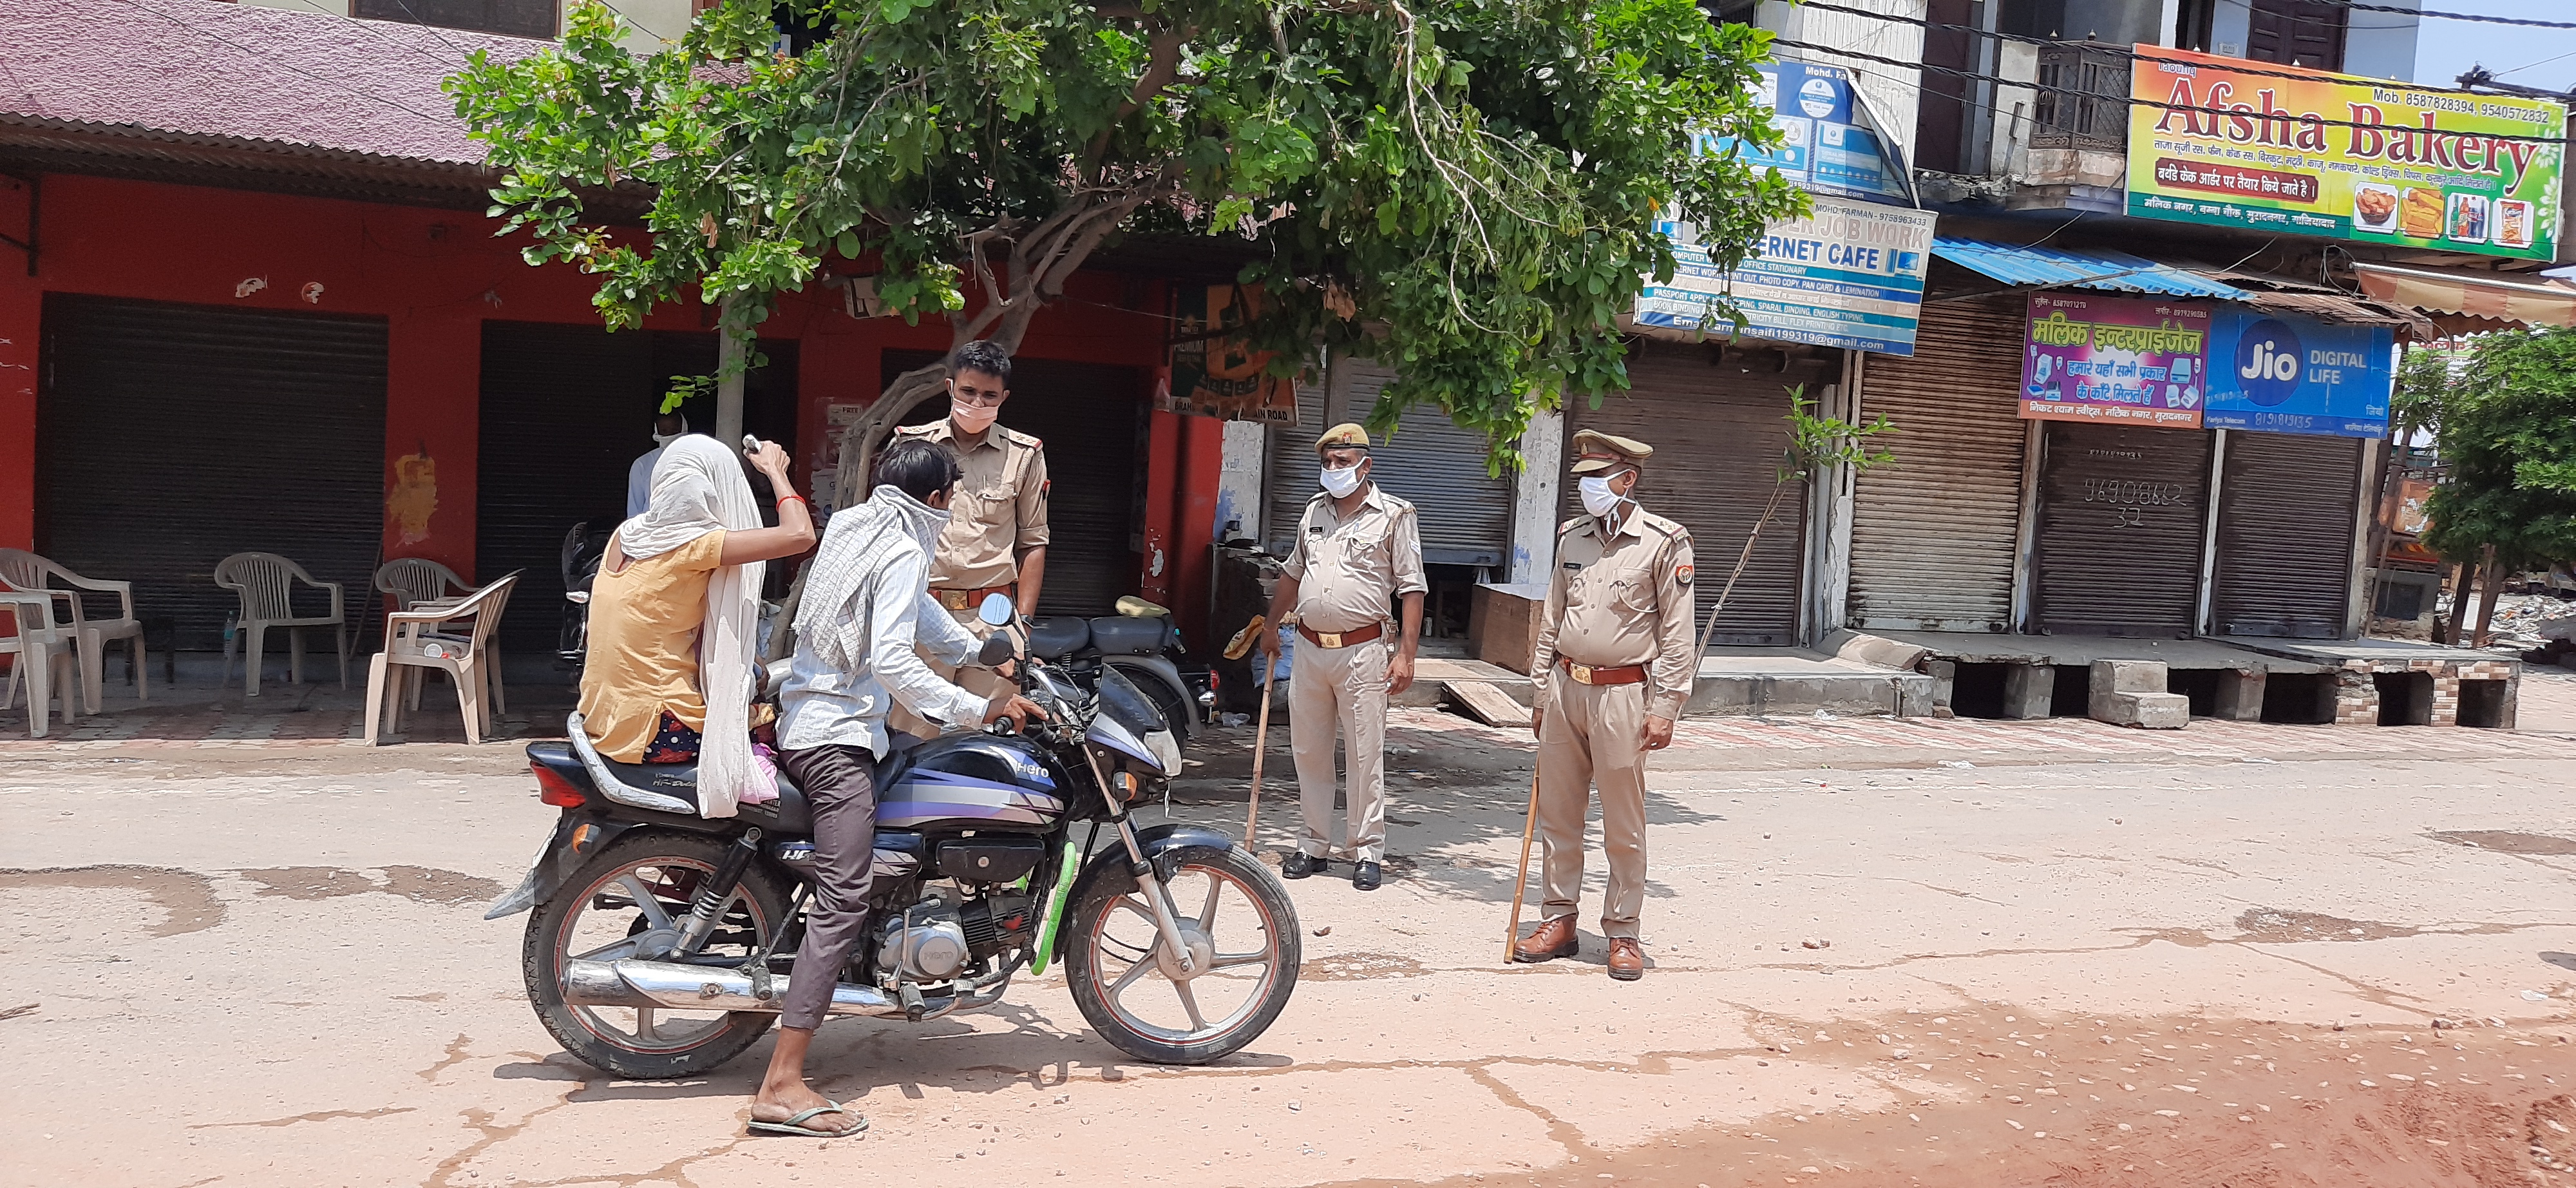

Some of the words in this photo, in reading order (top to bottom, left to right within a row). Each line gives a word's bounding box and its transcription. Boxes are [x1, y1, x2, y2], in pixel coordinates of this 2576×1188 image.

[1806, 66, 1833, 77] Mohd.
[2374, 89, 2401, 104] Mob.
[2406, 94, 2477, 115] 8587828394,
[2154, 78, 2327, 152] Afsha
[2345, 104, 2537, 195] Bakery
[2174, 141, 2190, 155] सूजी
[2179, 166, 2197, 183] केक
[2223, 175, 2235, 188] पर
[2237, 171, 2259, 191] तैयार
[2261, 177, 2279, 193] किये
[2281, 179, 2298, 196] जाते
[2144, 196, 2172, 209] मलिक
[1821, 216, 1861, 240] JOB
[1868, 221, 1927, 249] WORK
[1828, 243, 1879, 269] CAFE
[1759, 276, 1781, 285] PHOTO
[1802, 281, 1815, 289] PAN
[1816, 283, 1833, 292] CARD
[1654, 289, 1688, 300] PASSPORT
[2032, 311, 2091, 346] मलिक
[2241, 340, 2297, 381] Jio
[2310, 350, 2367, 369] DIGITAL
[2067, 358, 2092, 377] हमारे
[2095, 359, 2113, 377] यहाँ
[2116, 360, 2136, 378] सभी
[2139, 365, 2166, 381] प्रकार
[2309, 369, 2341, 385] LIFE
[2076, 380, 2088, 399] के
[2112, 383, 2141, 403] मिलते
[1267, 408, 1288, 421] ROAD
[2255, 412, 2313, 428] 8191819135
[1018, 762, 1049, 778] Hero
[923, 951, 953, 960] Hero
